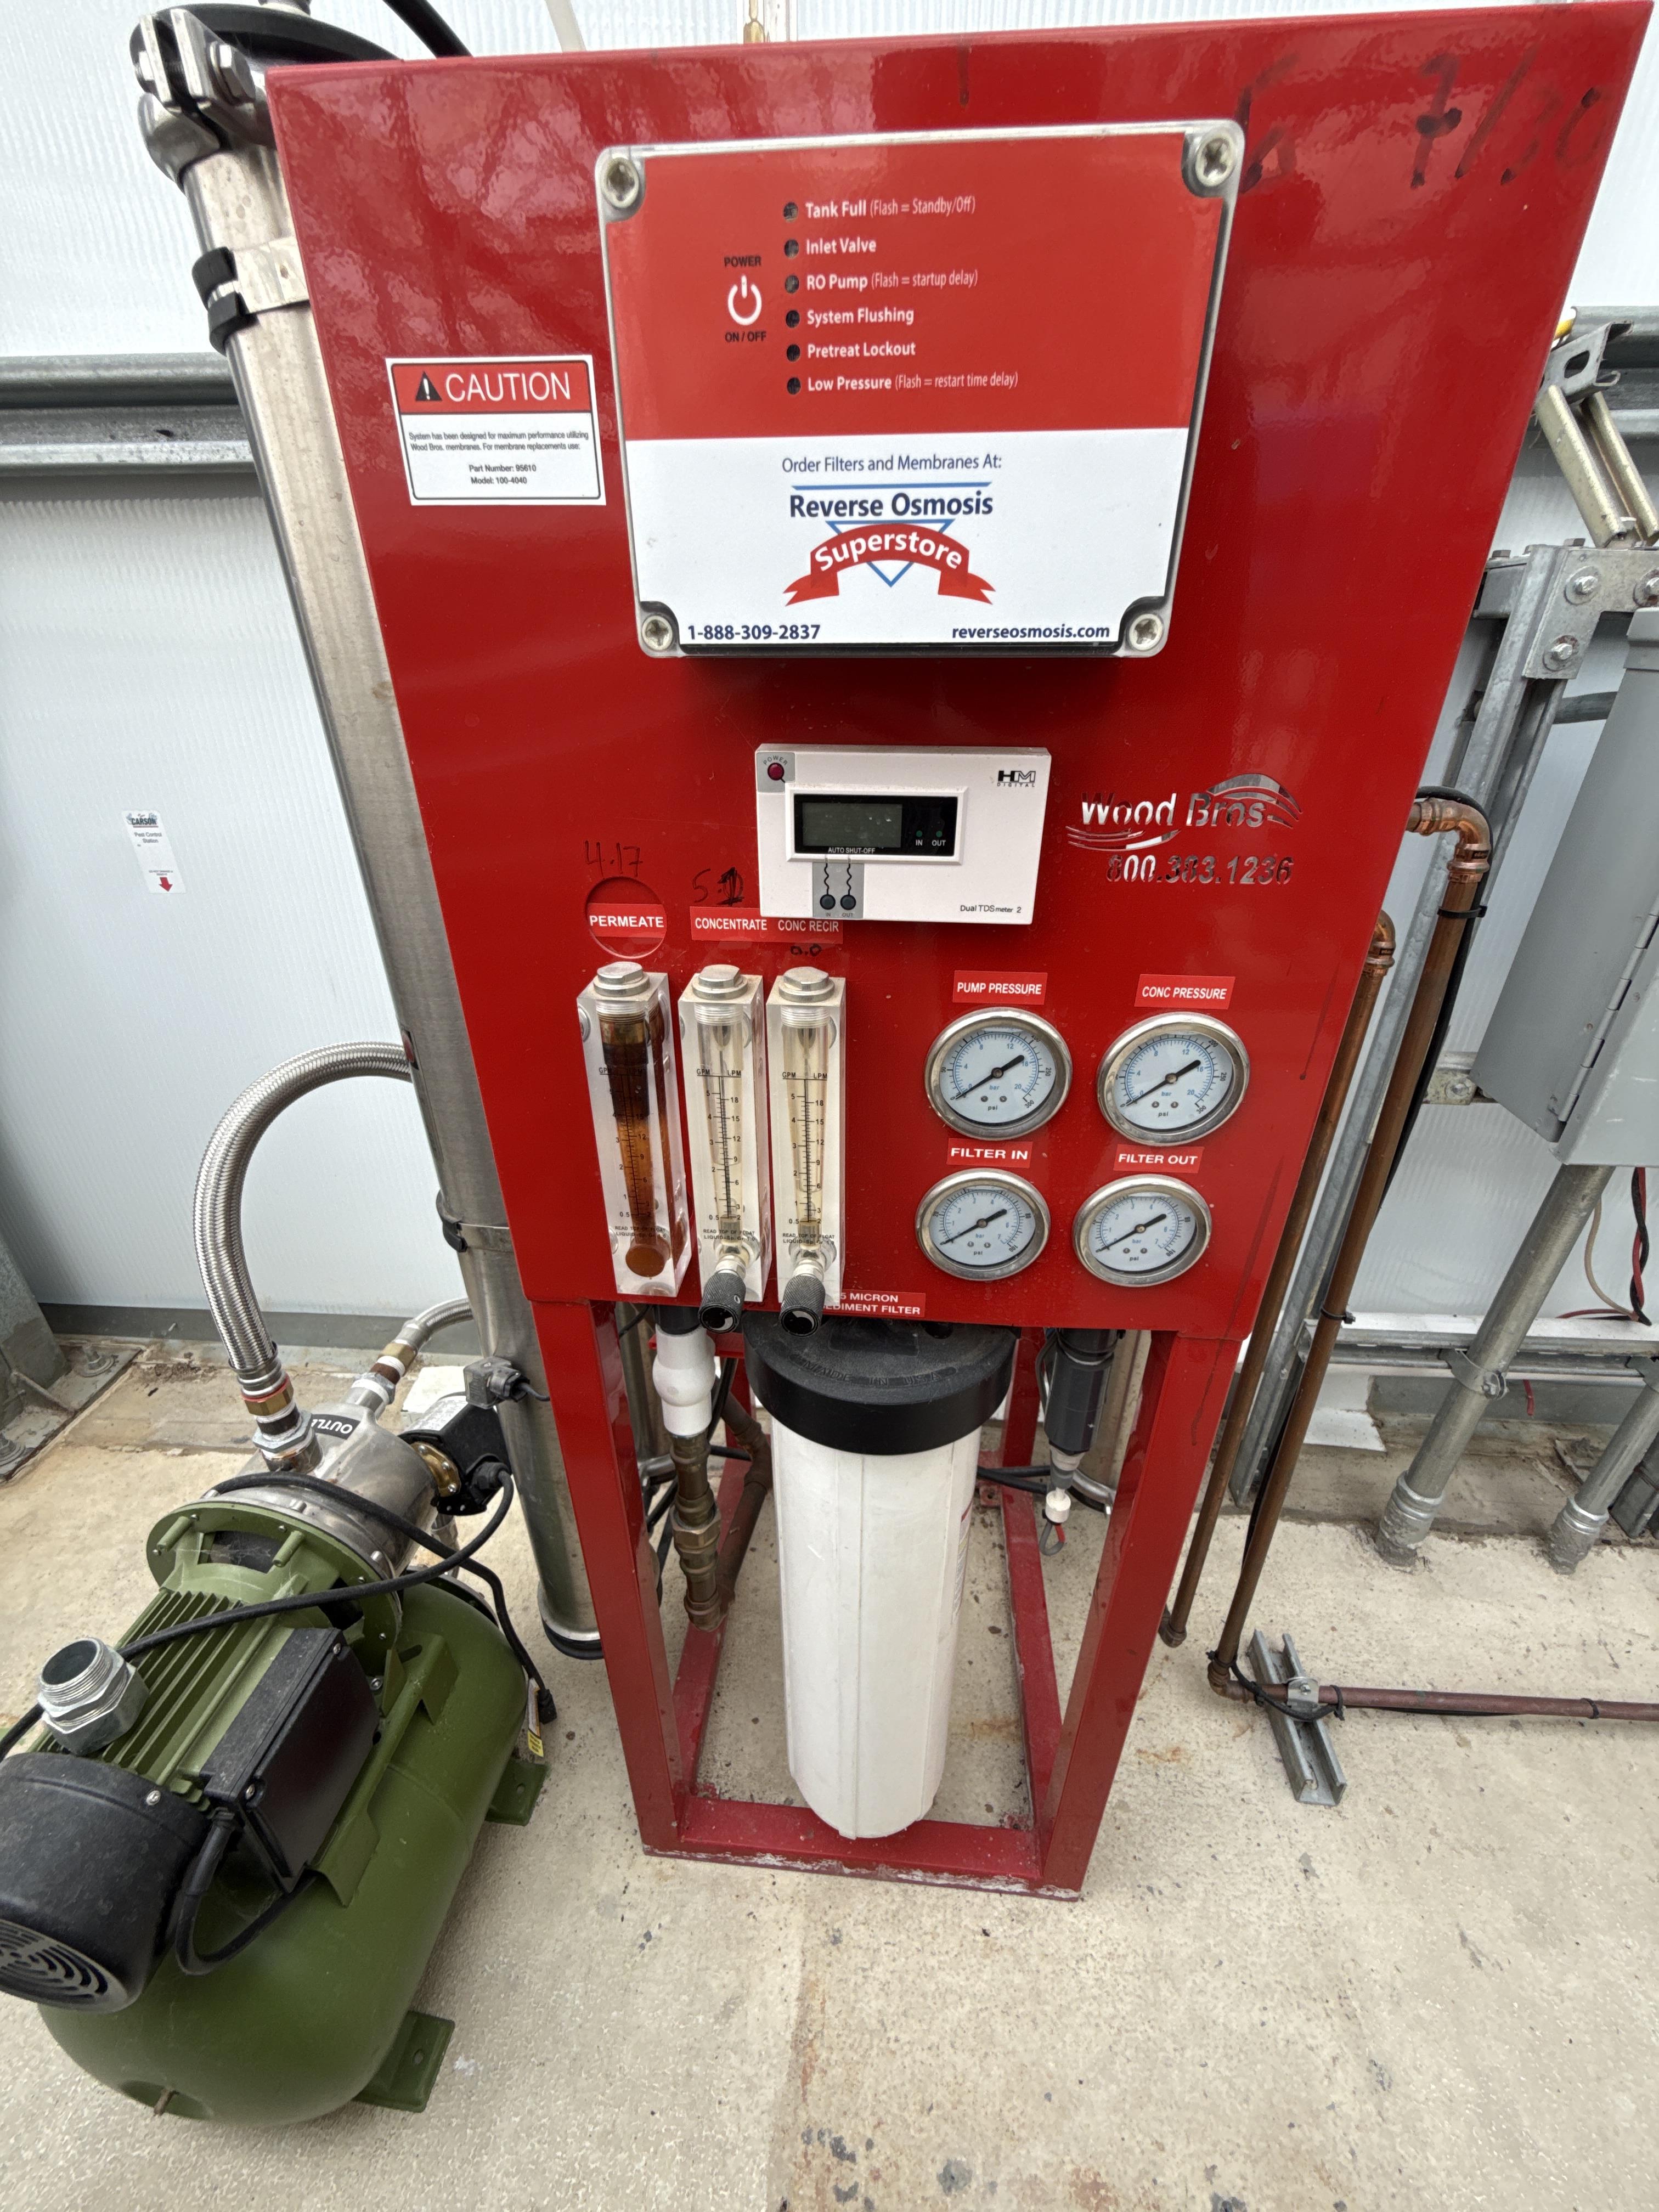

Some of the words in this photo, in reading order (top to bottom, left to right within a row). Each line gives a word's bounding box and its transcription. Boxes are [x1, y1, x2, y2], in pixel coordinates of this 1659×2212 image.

[806, 202, 838, 218] Tank
[842, 201, 866, 217] Full
[870, 199, 898, 217] (Flash
[912, 196, 975, 215] Standby/Off)
[806, 238, 836, 255] Inlet
[839, 238, 877, 253] Valve
[724, 256, 761, 267] POWER
[806, 275, 826, 290] RO
[829, 275, 868, 292] Pump
[871, 273, 898, 290] (Flash
[912, 272, 946, 289] startup
[949, 270, 978, 286] delay)
[807, 310, 854, 326] System
[857, 308, 915, 325] Flushing
[725, 332, 740, 343] ON
[742, 332, 746, 342] /
[748, 331, 766, 342] OFF
[808, 343, 860, 358] Pretreat
[864, 342, 916, 357] Lockout
[445, 372, 571, 402] CAUTION
[808, 376, 833, 391] Low
[837, 376, 892, 390] Pressure
[895, 375, 921, 391] (Flash
[935, 375, 964, 387] restart
[967, 375, 988, 387] time
[990, 373, 1018, 388] delay)
[409, 432, 431, 441] System
[460, 432, 487, 441] designed
[528, 431, 565, 441] performance
[567, 431, 589, 440] utilizing
[527, 443, 566, 452] replacements
[782, 457, 821, 472] Order
[824, 456, 865, 472] Filters
[868, 456, 893, 471] and
[898, 455, 979, 470] Membranes
[983, 455, 1002, 469] At:
[790, 494, 884, 518] Reverse
[891, 491, 994, 516] Osmosis
[814, 532, 963, 572] Superstore
[688, 625, 820, 640] 1-888-309-2837
[952, 623, 1110, 640] reverseosmosis.com
[763, 755, 788, 765] POWER
[1081, 793, 1177, 825] Wood
[1186, 793, 1266, 827] Bros
[590, 915, 664, 928] PERMEATE
[695, 917, 768, 930] CONCENTRATE
[778, 919, 808, 932] CONC
[809, 920, 839, 932] RECIR
[957, 982, 987, 994] PUMP
[989, 983, 1042, 995] PRESSURE
[1142, 986, 1170, 998] CONC
[1173, 986, 1227, 1000] PRESSURE
[1025, 1100, 1034, 1108] 300
[1197, 1105, 1206, 1114] 300
[951, 1148, 1006, 1160] FILTER
[1011, 1150, 1028, 1160] IN
[1119, 1154, 1165, 1164] FILTER
[1168, 1155, 1197, 1165] OUT
[850, 1293, 898, 1302] MICRON
[882, 1305, 920, 1314] FILTER
[804, 1361, 851, 1381] MADE
[870, 1377, 889, 1386] IN
[905, 1373, 941, 1385] USA
